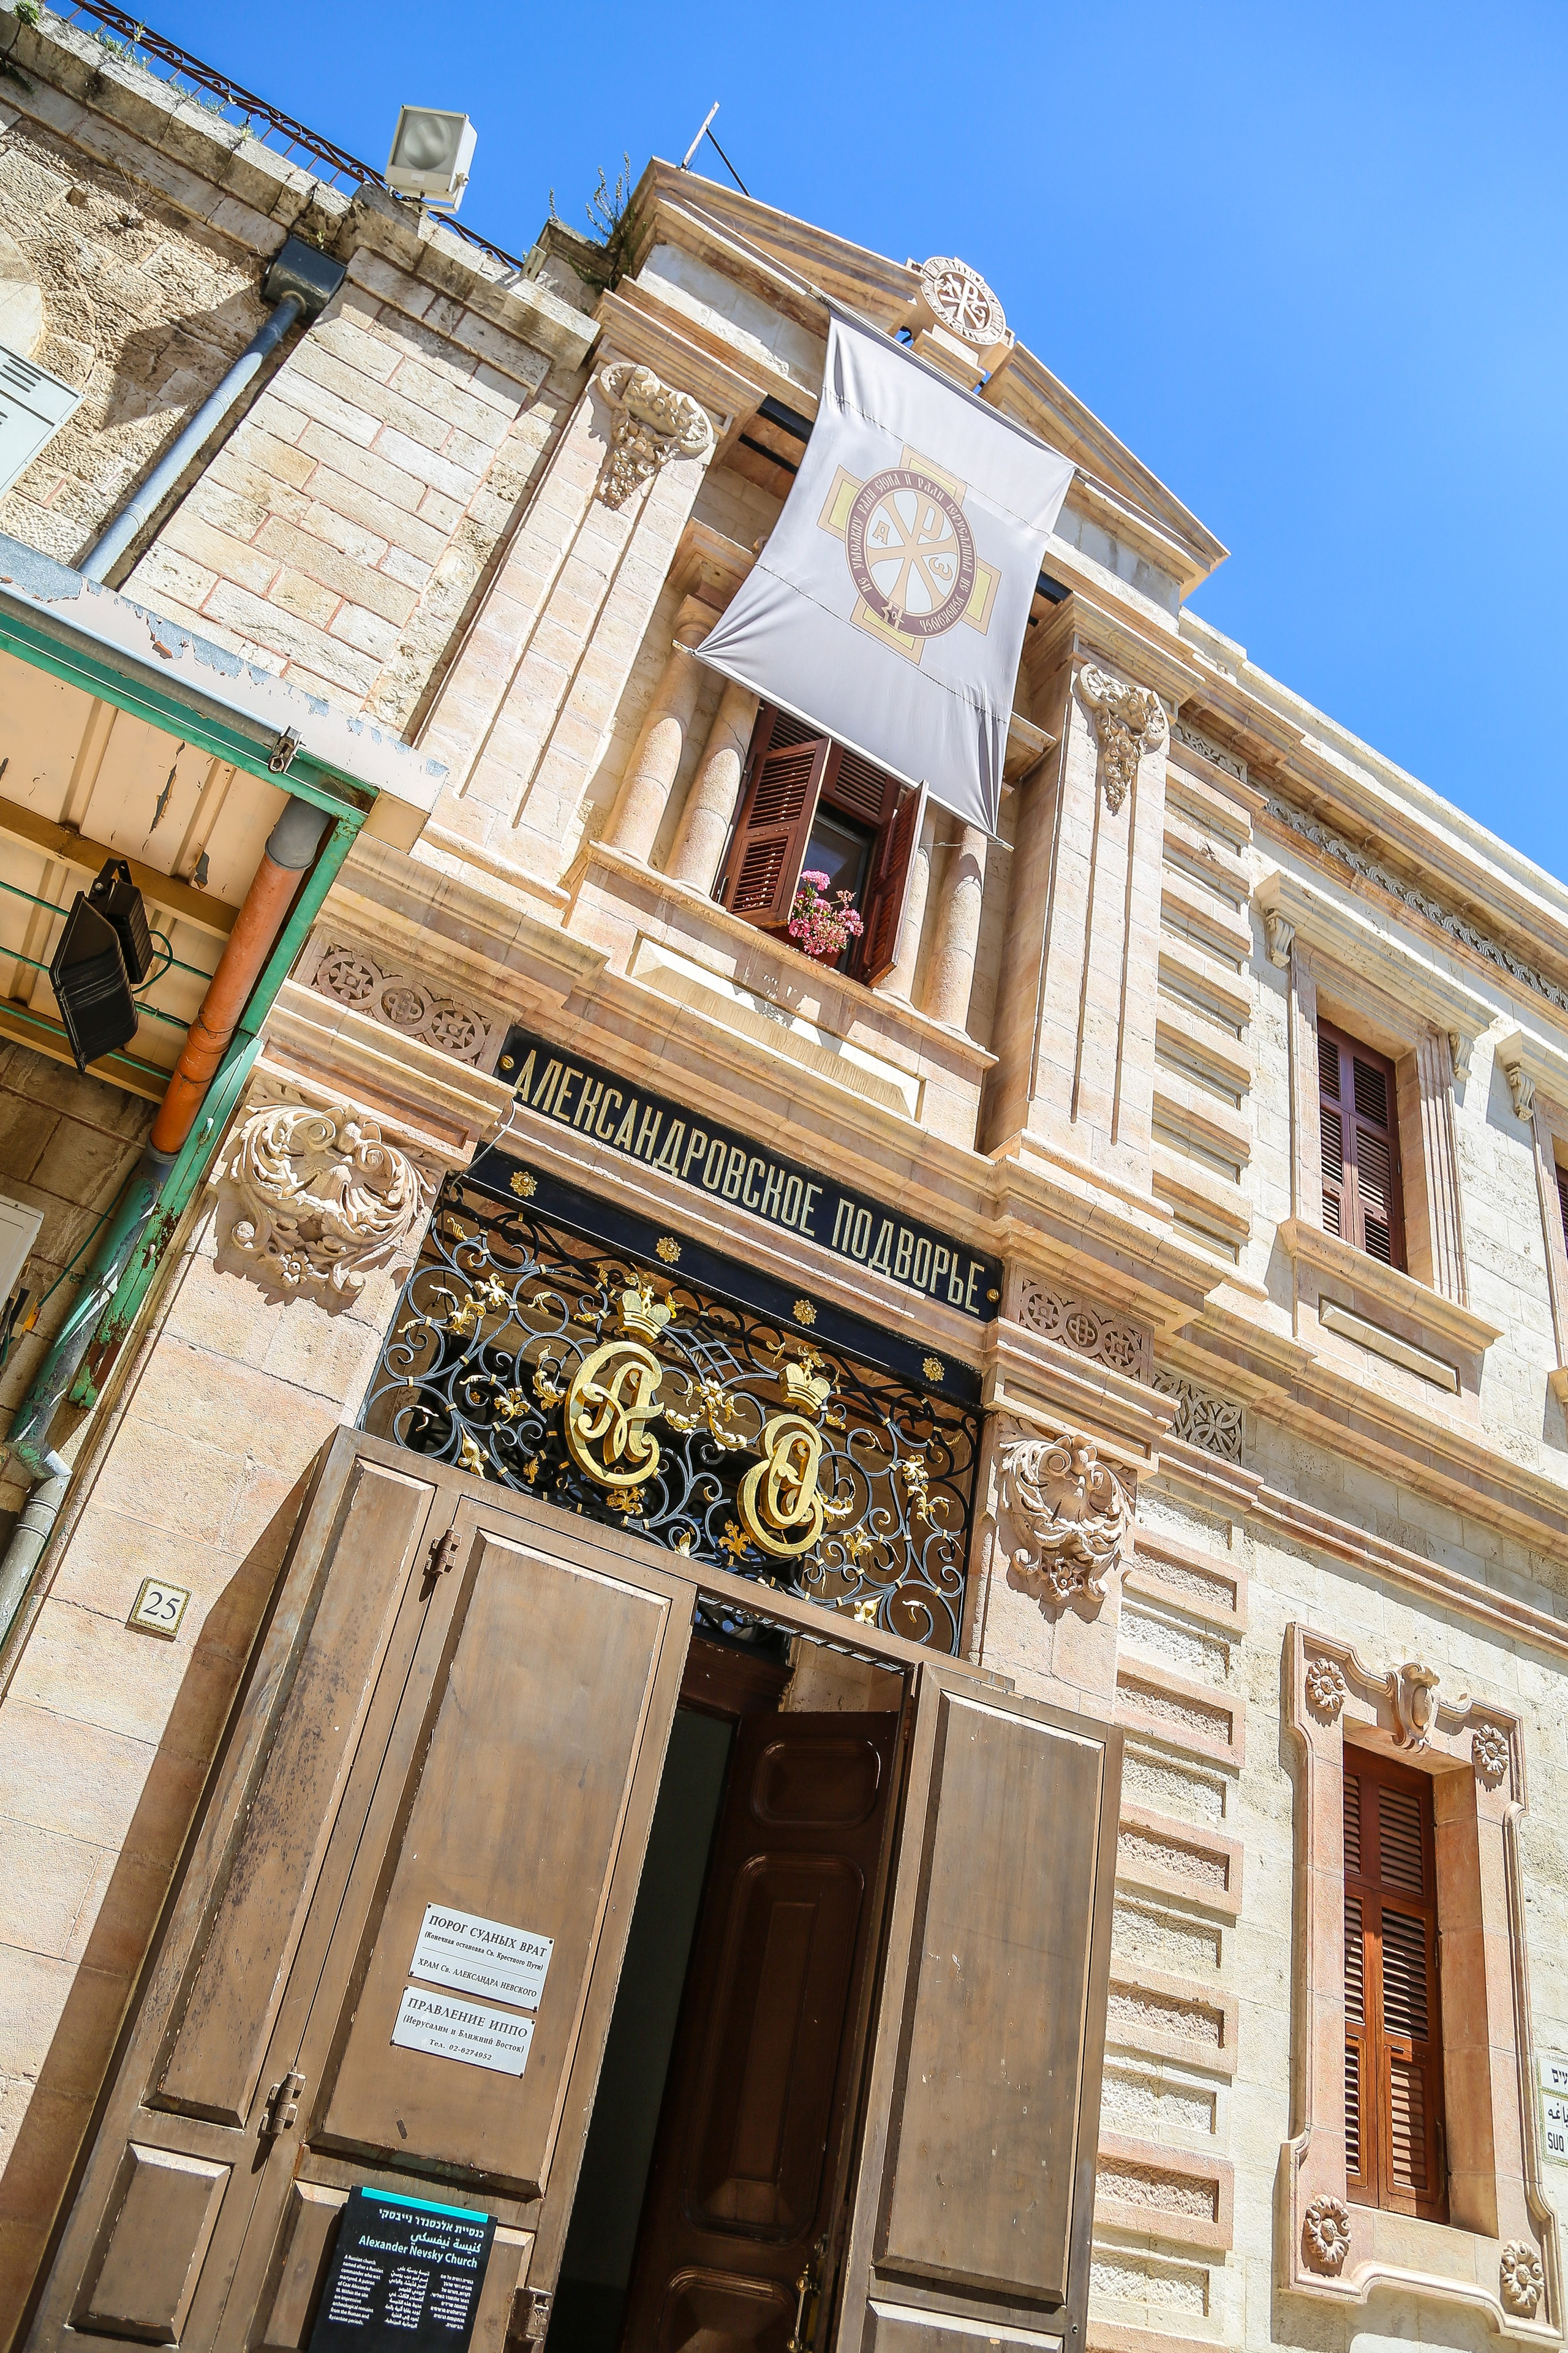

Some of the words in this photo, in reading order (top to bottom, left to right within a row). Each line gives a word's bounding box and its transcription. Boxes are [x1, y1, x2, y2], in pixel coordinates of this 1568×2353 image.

[514, 1049, 823, 1237] АЛЕКСАНДРОВСКОЕ
[831, 1199, 985, 1315] ПОДВОРЬЕ
[143, 1591, 181, 1620] 25
[429, 1915, 468, 1934] ПОРОГ
[470, 1927, 518, 1949] СУДНЫХ
[519, 1942, 547, 1957] ВРАТ
[424, 1931, 454, 1944] (Конечная
[456, 1941, 484, 1954] остановка
[496, 1952, 525, 1966] Крестного
[527, 1961, 543, 1971] Пути)
[418, 1958, 440, 1970] ХРАМ
[453, 1969, 499, 1987] АЛЕКСАНДРА
[500, 1982, 537, 1997] НЕВСКОГО
[407, 1998, 486, 2026] ПРАВЛЕНИЕ
[488, 2020, 527, 2038] ИППО
[403, 2014, 448, 2033] (Иерусалим
[458, 2030, 493, 2045] Ближний
[496, 2039, 524, 2053] Восток)
[429, 2039, 445, 2049] Тел.
[449, 2045, 492, 2060] 02-6274952
[1548, 2131, 1564, 2153] SUQ
[379, 2208, 413, 2224] נייבסקי
[415, 2216, 453, 2232] אלכסנדר
[410, 2232, 451, 2249] نيفسكي
[454, 2224, 484, 2238] כנסיית
[358, 2235, 408, 2254] Alexander
[409, 2246, 443, 2263] Nevsky
[445, 2253, 478, 2268] Church
[453, 2238, 481, 2254] كنيسة
[341, 2268, 364, 2276] commander
[332, 2301, 358, 2310] archeological
[341, 2295, 361, 2303] impressive
